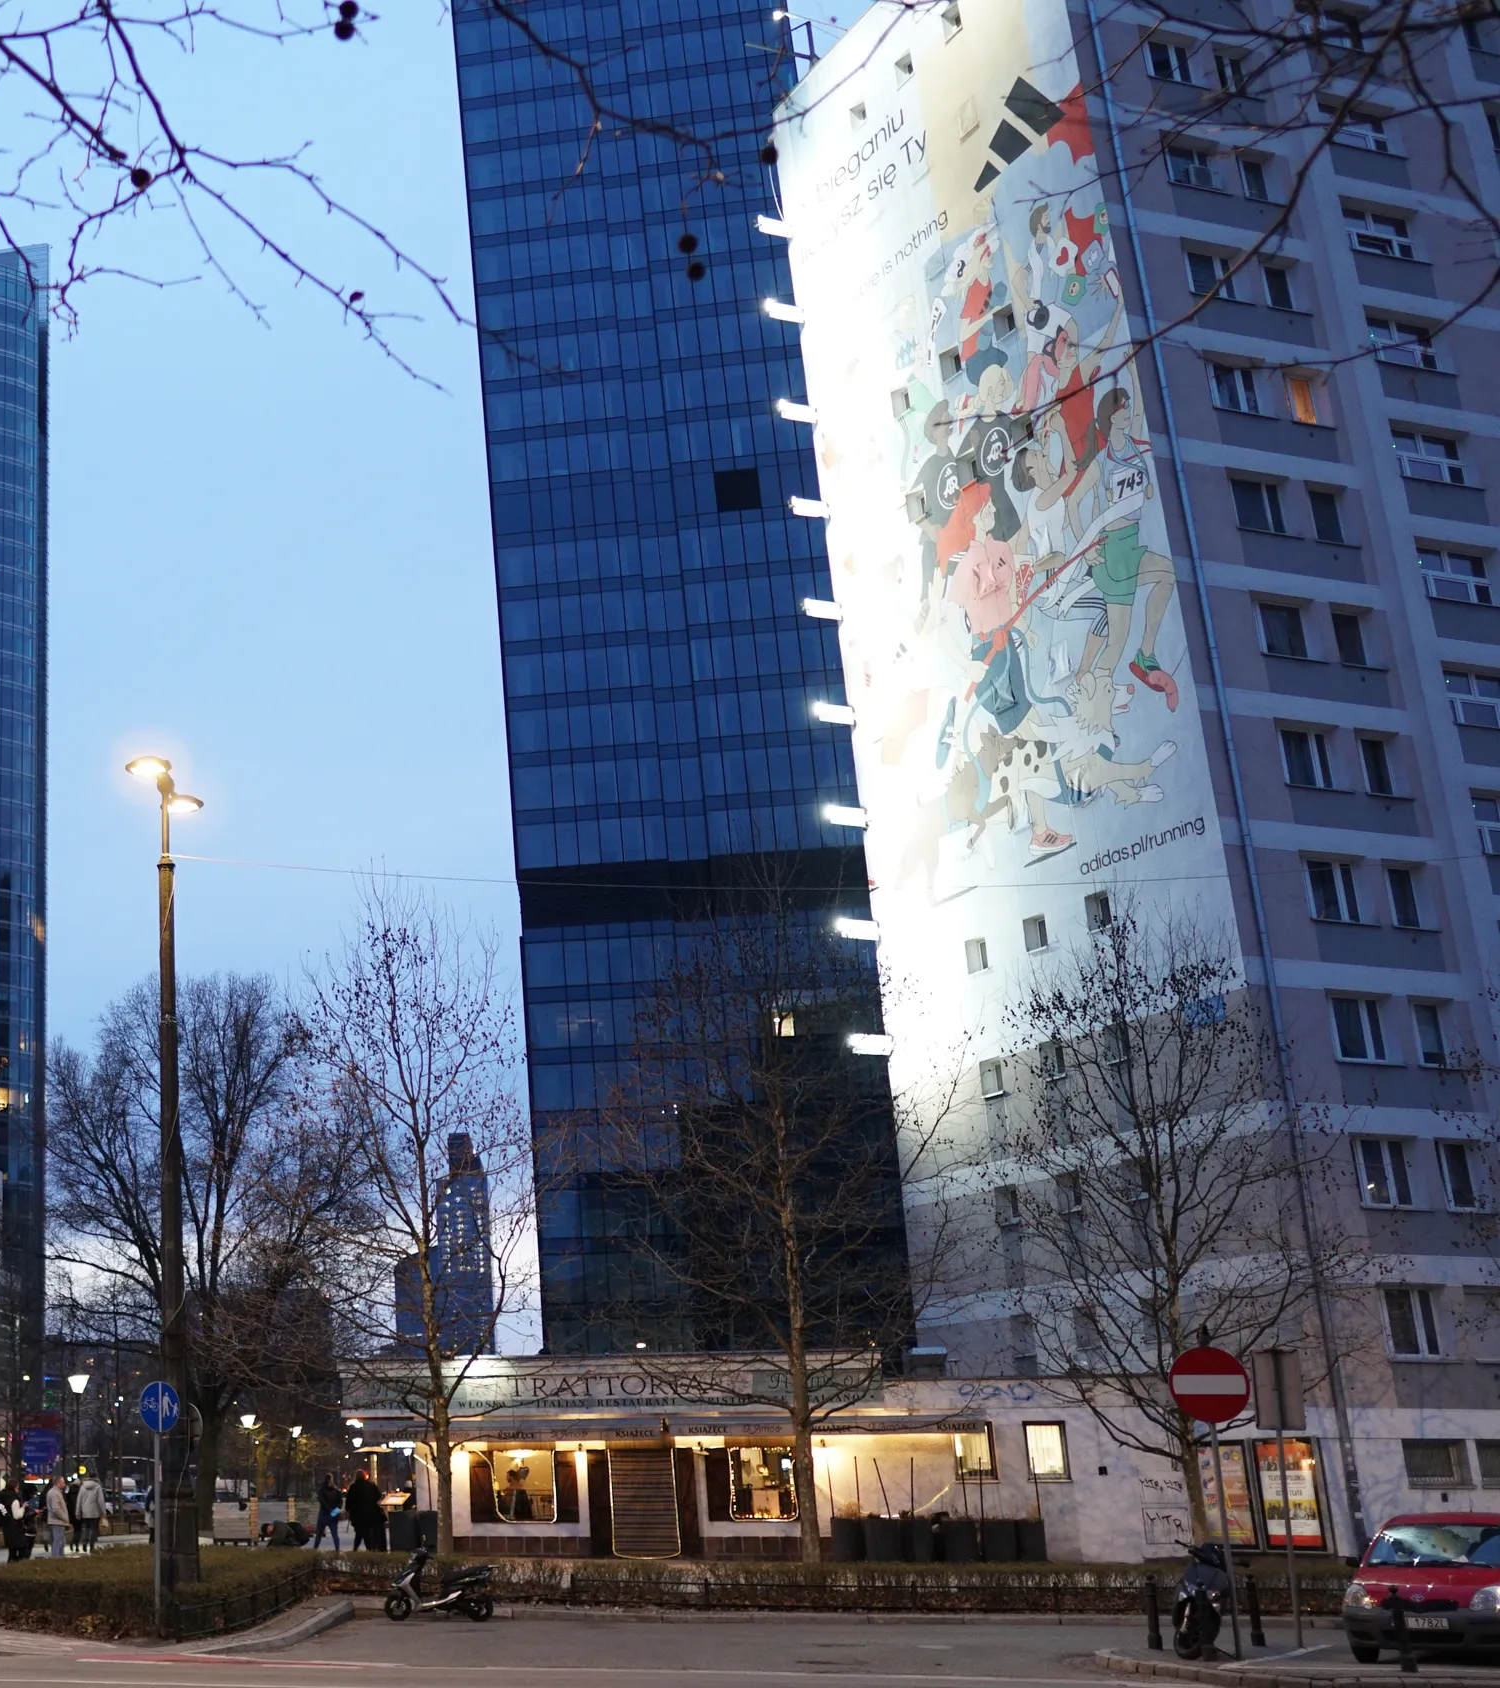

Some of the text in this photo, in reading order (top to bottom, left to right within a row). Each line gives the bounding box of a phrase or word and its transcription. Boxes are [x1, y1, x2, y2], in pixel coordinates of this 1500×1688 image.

[867, 163, 897, 201] się
[900, 129, 927, 165] Ty
[894, 209, 949, 266] nothing
[1116, 470, 1144, 500] 743
[1079, 816, 1206, 876] adidas.pl/running
[506, 1374, 709, 1398] TRATTORIA
[597, 1397, 677, 1408] RESTAURANT
